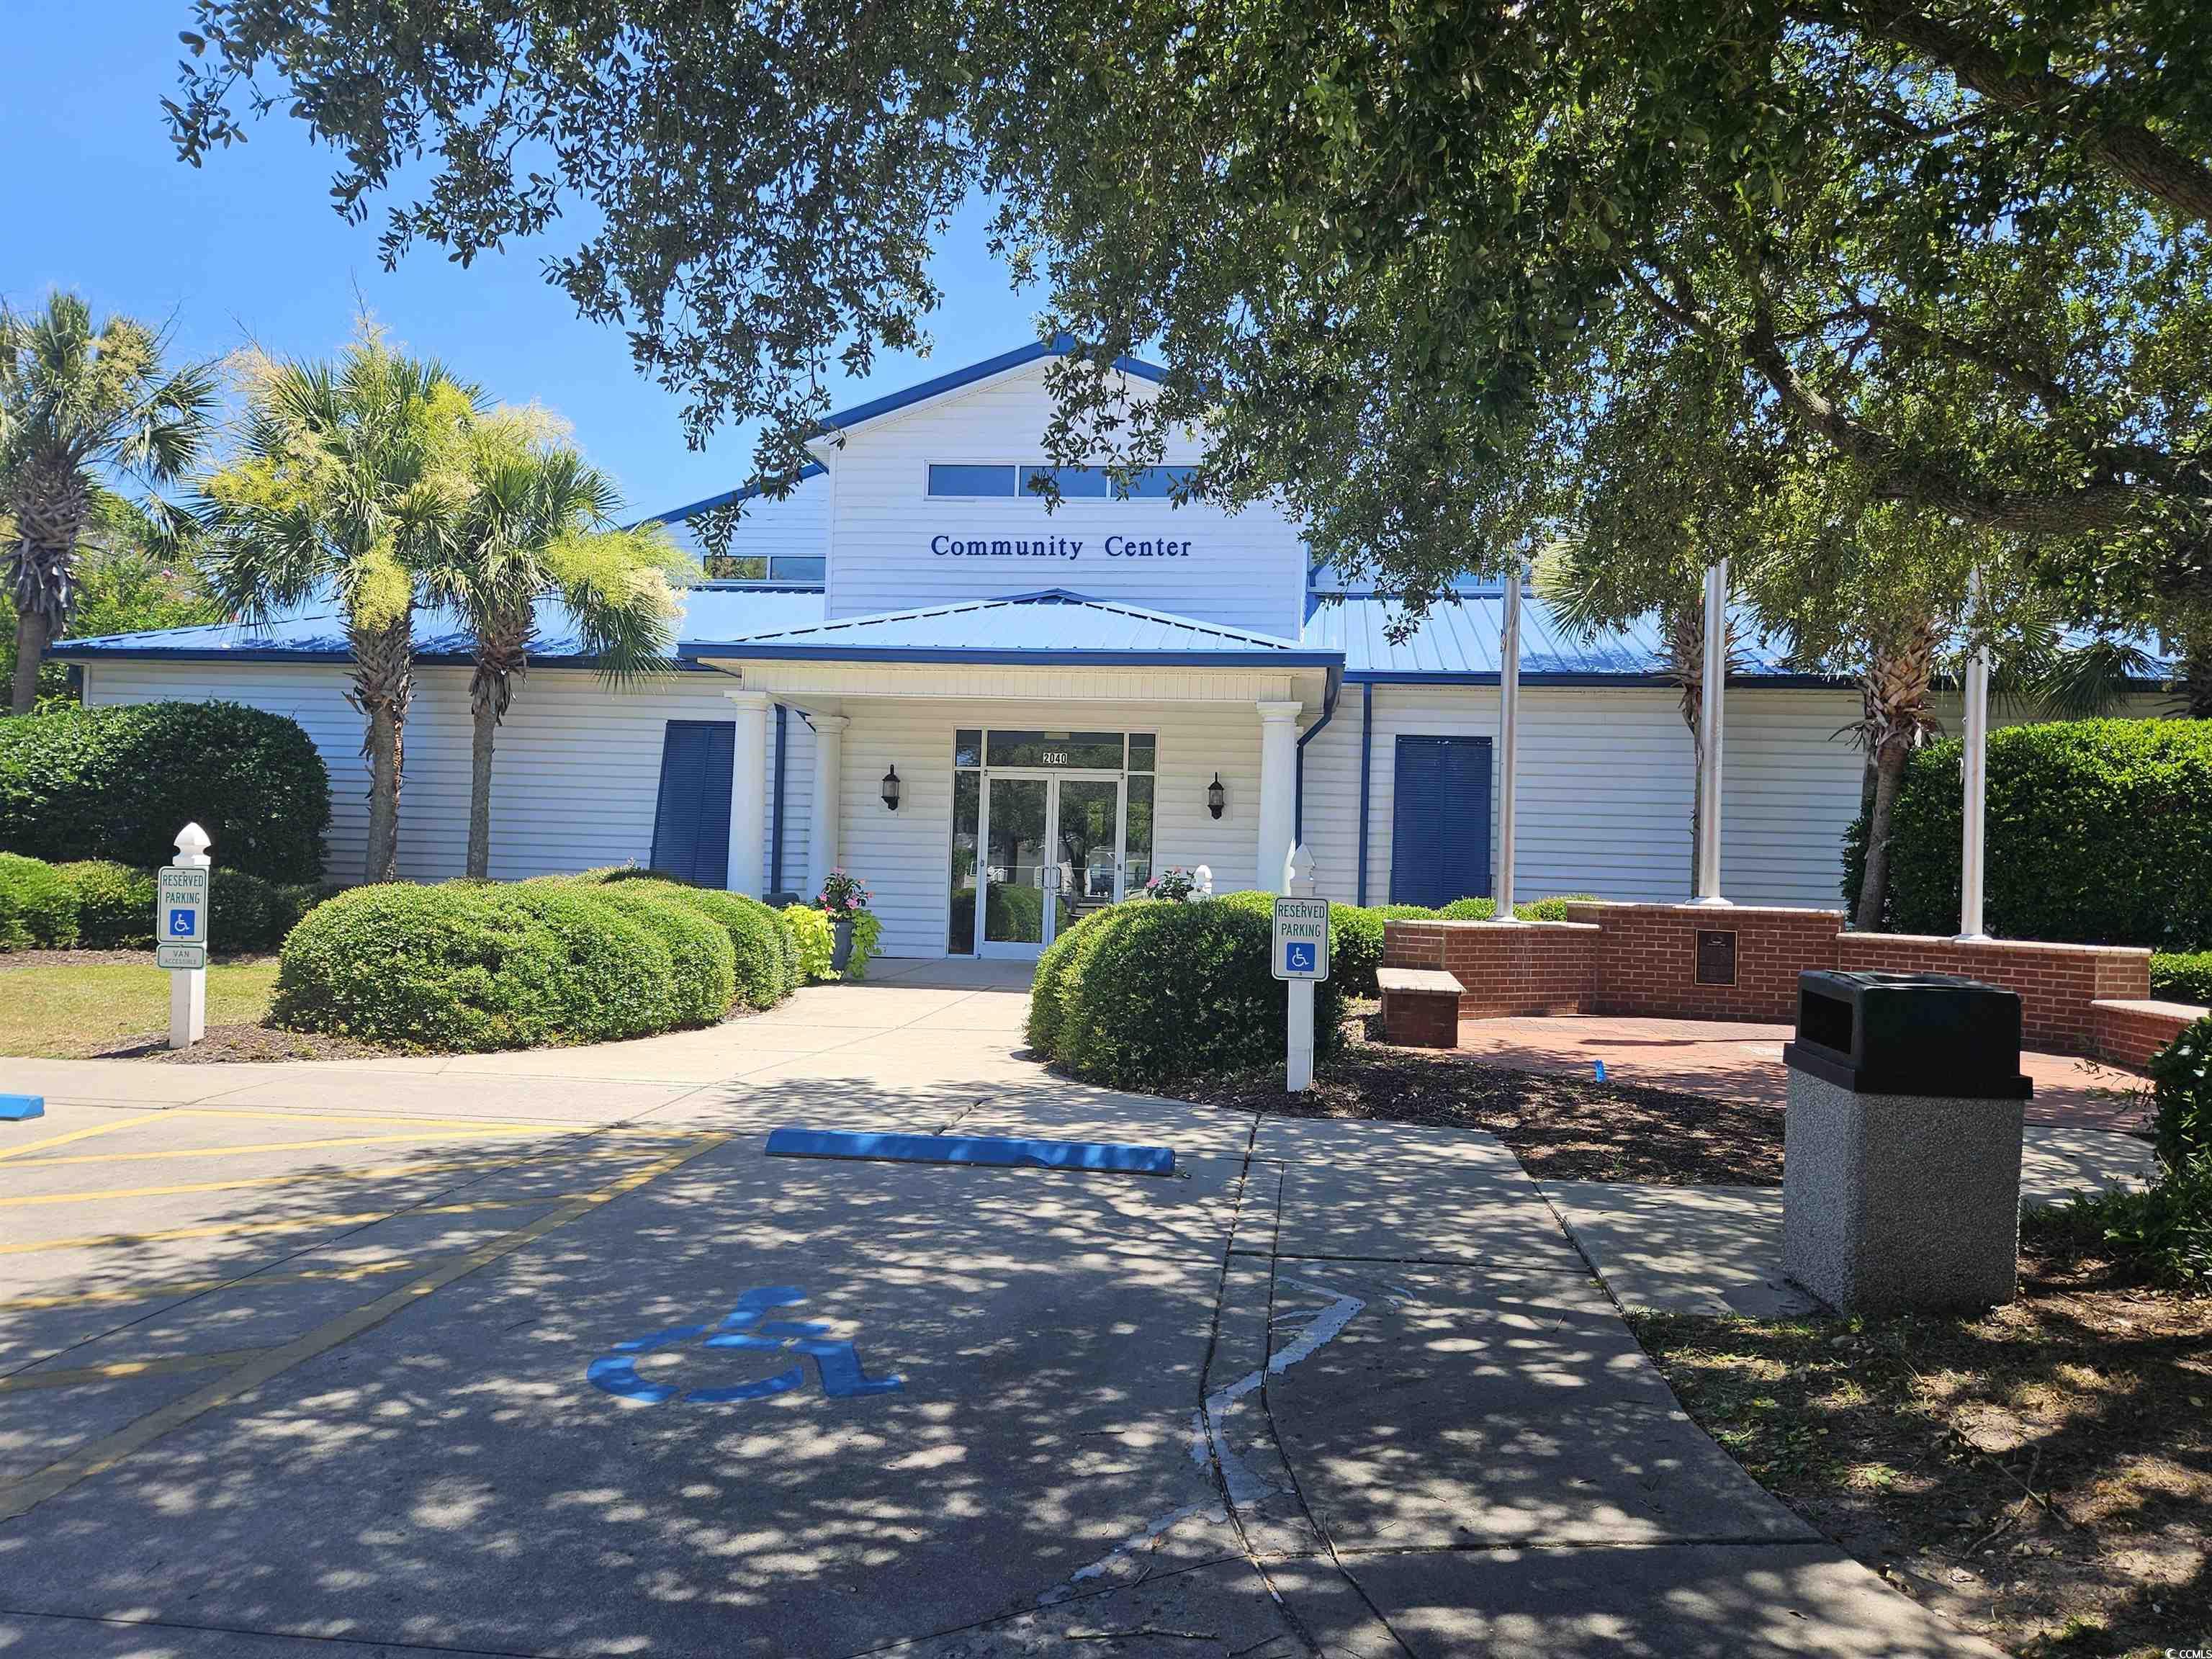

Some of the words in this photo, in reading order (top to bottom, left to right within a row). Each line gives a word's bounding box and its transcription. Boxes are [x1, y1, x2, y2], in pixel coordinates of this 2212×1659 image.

[930, 535, 1083, 560] Community
[1105, 536, 1192, 557] Center
[1044, 753, 1066, 763] 2040
[163, 874, 203, 886] RESERVED
[166, 892, 200, 904] PARKING
[1278, 904, 1325, 918] RESERVED
[1282, 923, 1321, 937] PARKING
